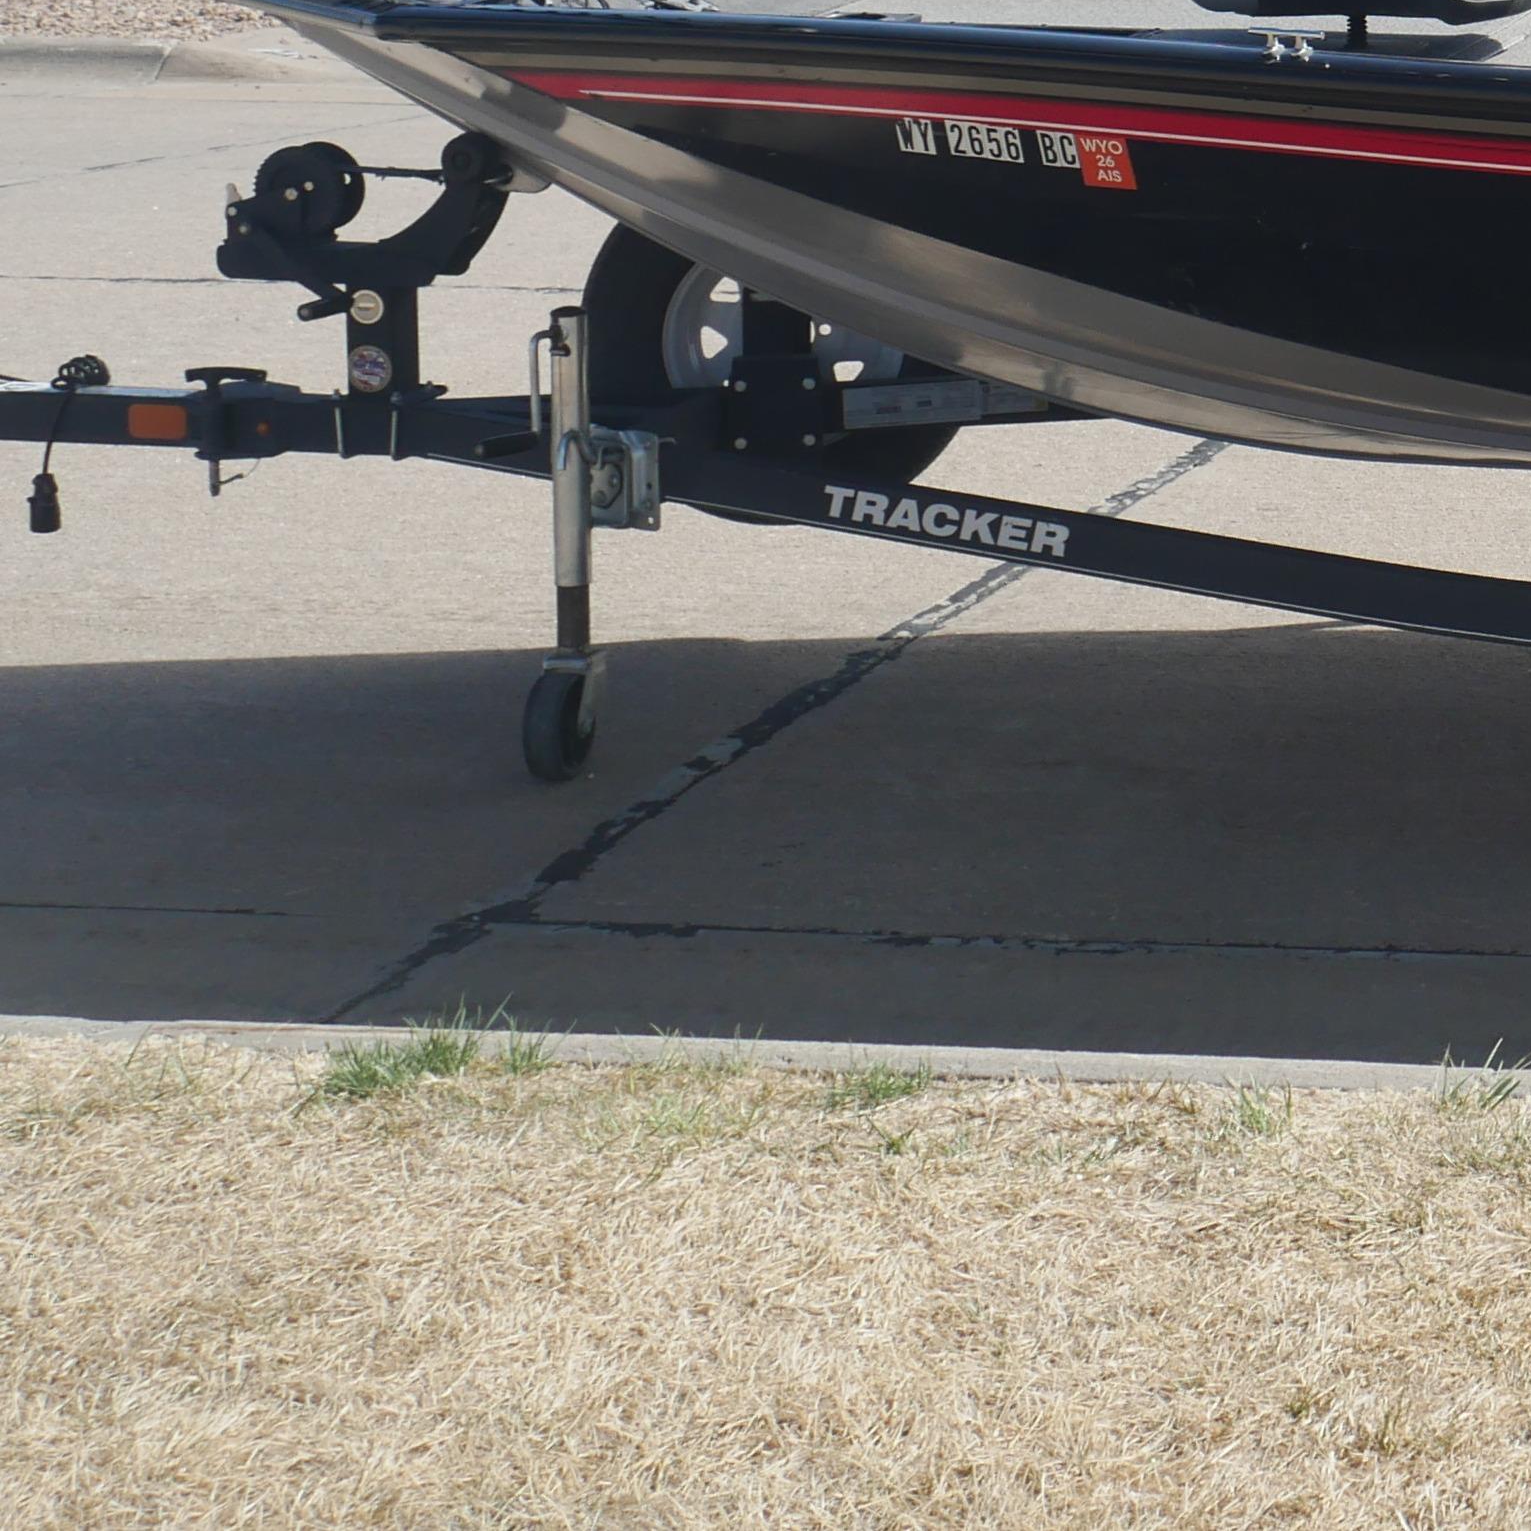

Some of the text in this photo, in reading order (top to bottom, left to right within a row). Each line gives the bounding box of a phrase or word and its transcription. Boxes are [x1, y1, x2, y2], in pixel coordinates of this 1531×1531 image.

[896, 119, 1077, 166] WY 2656 BC
[1080, 137, 1123, 155] WYO
[1097, 155, 1116, 168] 26
[1098, 169, 1123, 183] AIS
[824, 484, 1070, 557] TRACKER
